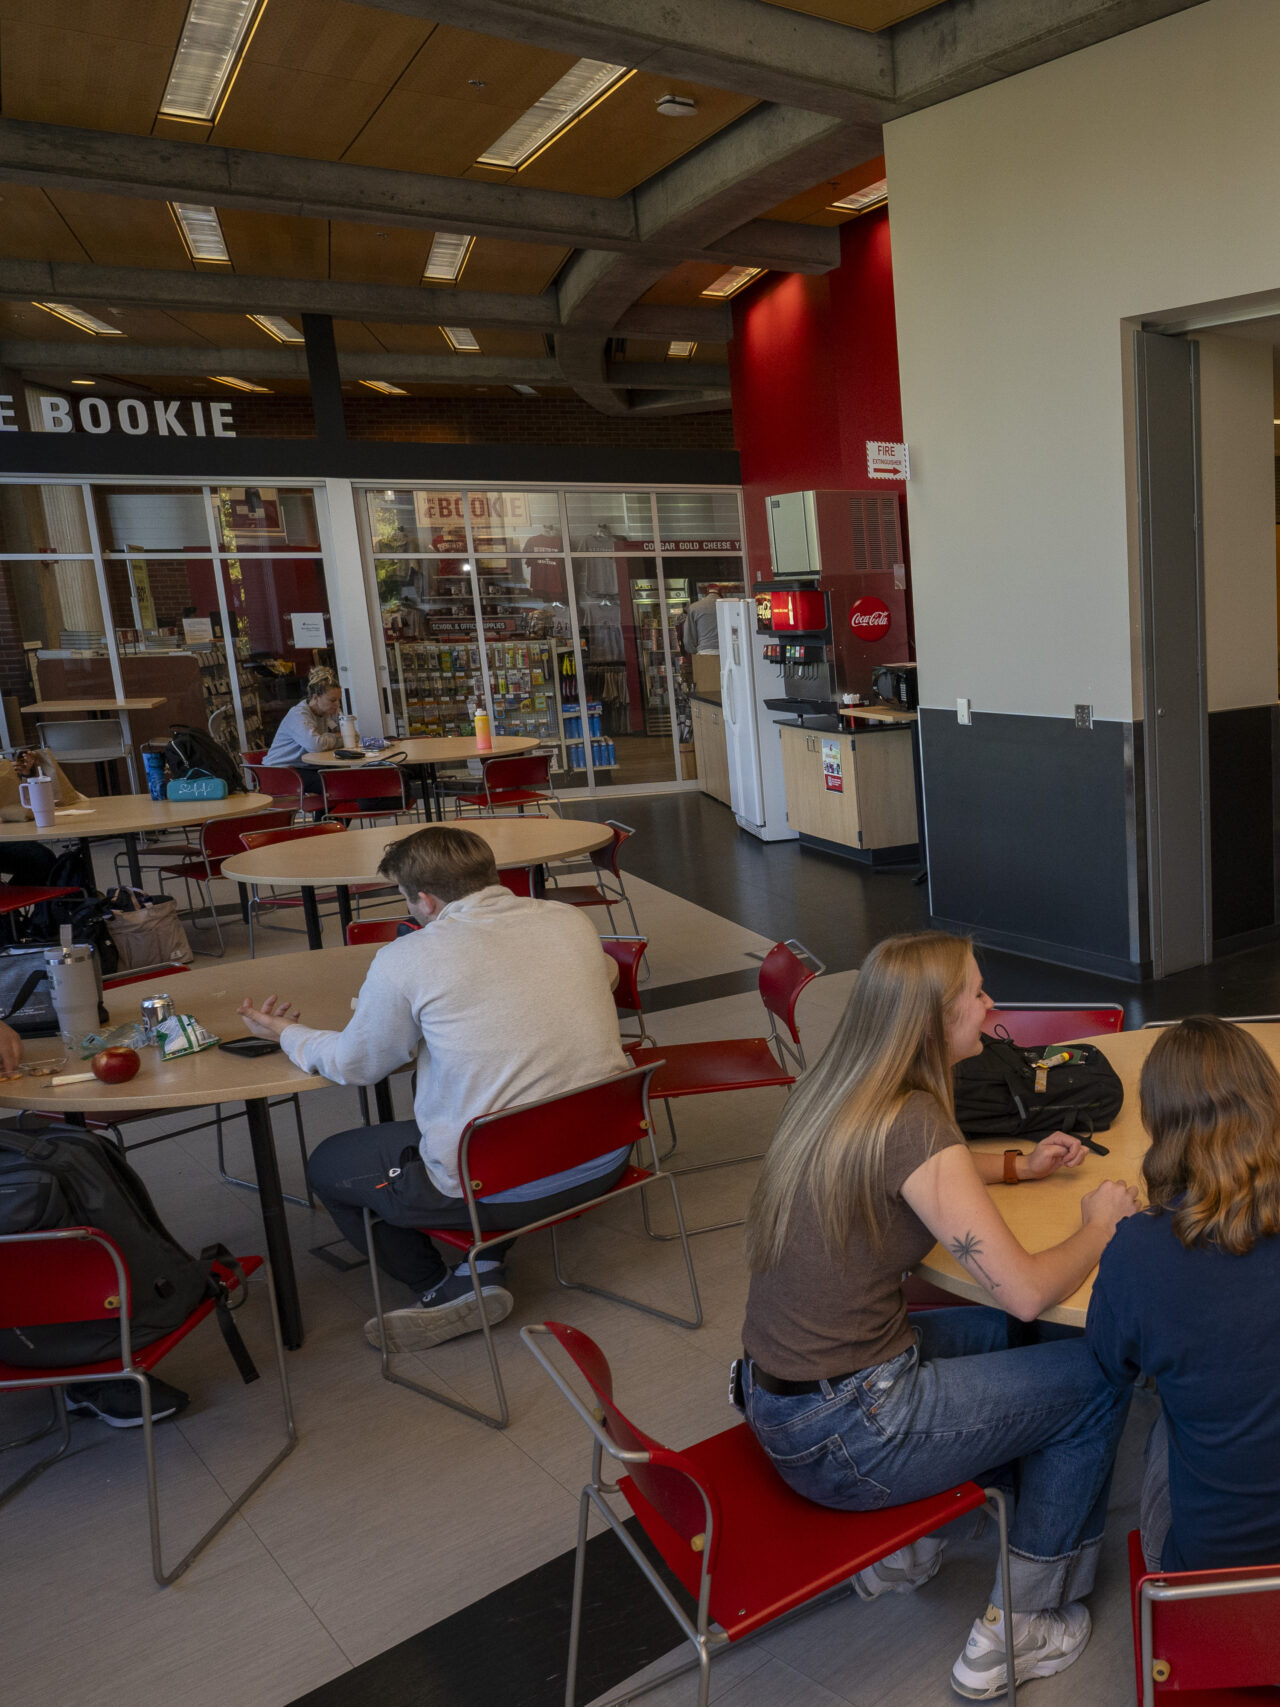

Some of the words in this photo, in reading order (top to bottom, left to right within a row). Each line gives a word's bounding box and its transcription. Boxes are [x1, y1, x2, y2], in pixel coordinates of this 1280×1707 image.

[40, 396, 237, 438] BOOKIE
[877, 445, 896, 457] FIRE
[872, 458, 902, 466] EXTINGUISHER
[643, 542, 676, 551] COGAR
[679, 541, 700, 550] GOLD
[703, 541, 732, 550] CHEESE
[851, 611, 889, 627] Coca-Cola
[432, 623, 454, 631] SCHOOL
[460, 622, 479, 631] OFFIC
[482, 622, 505, 630] UPPLIES
